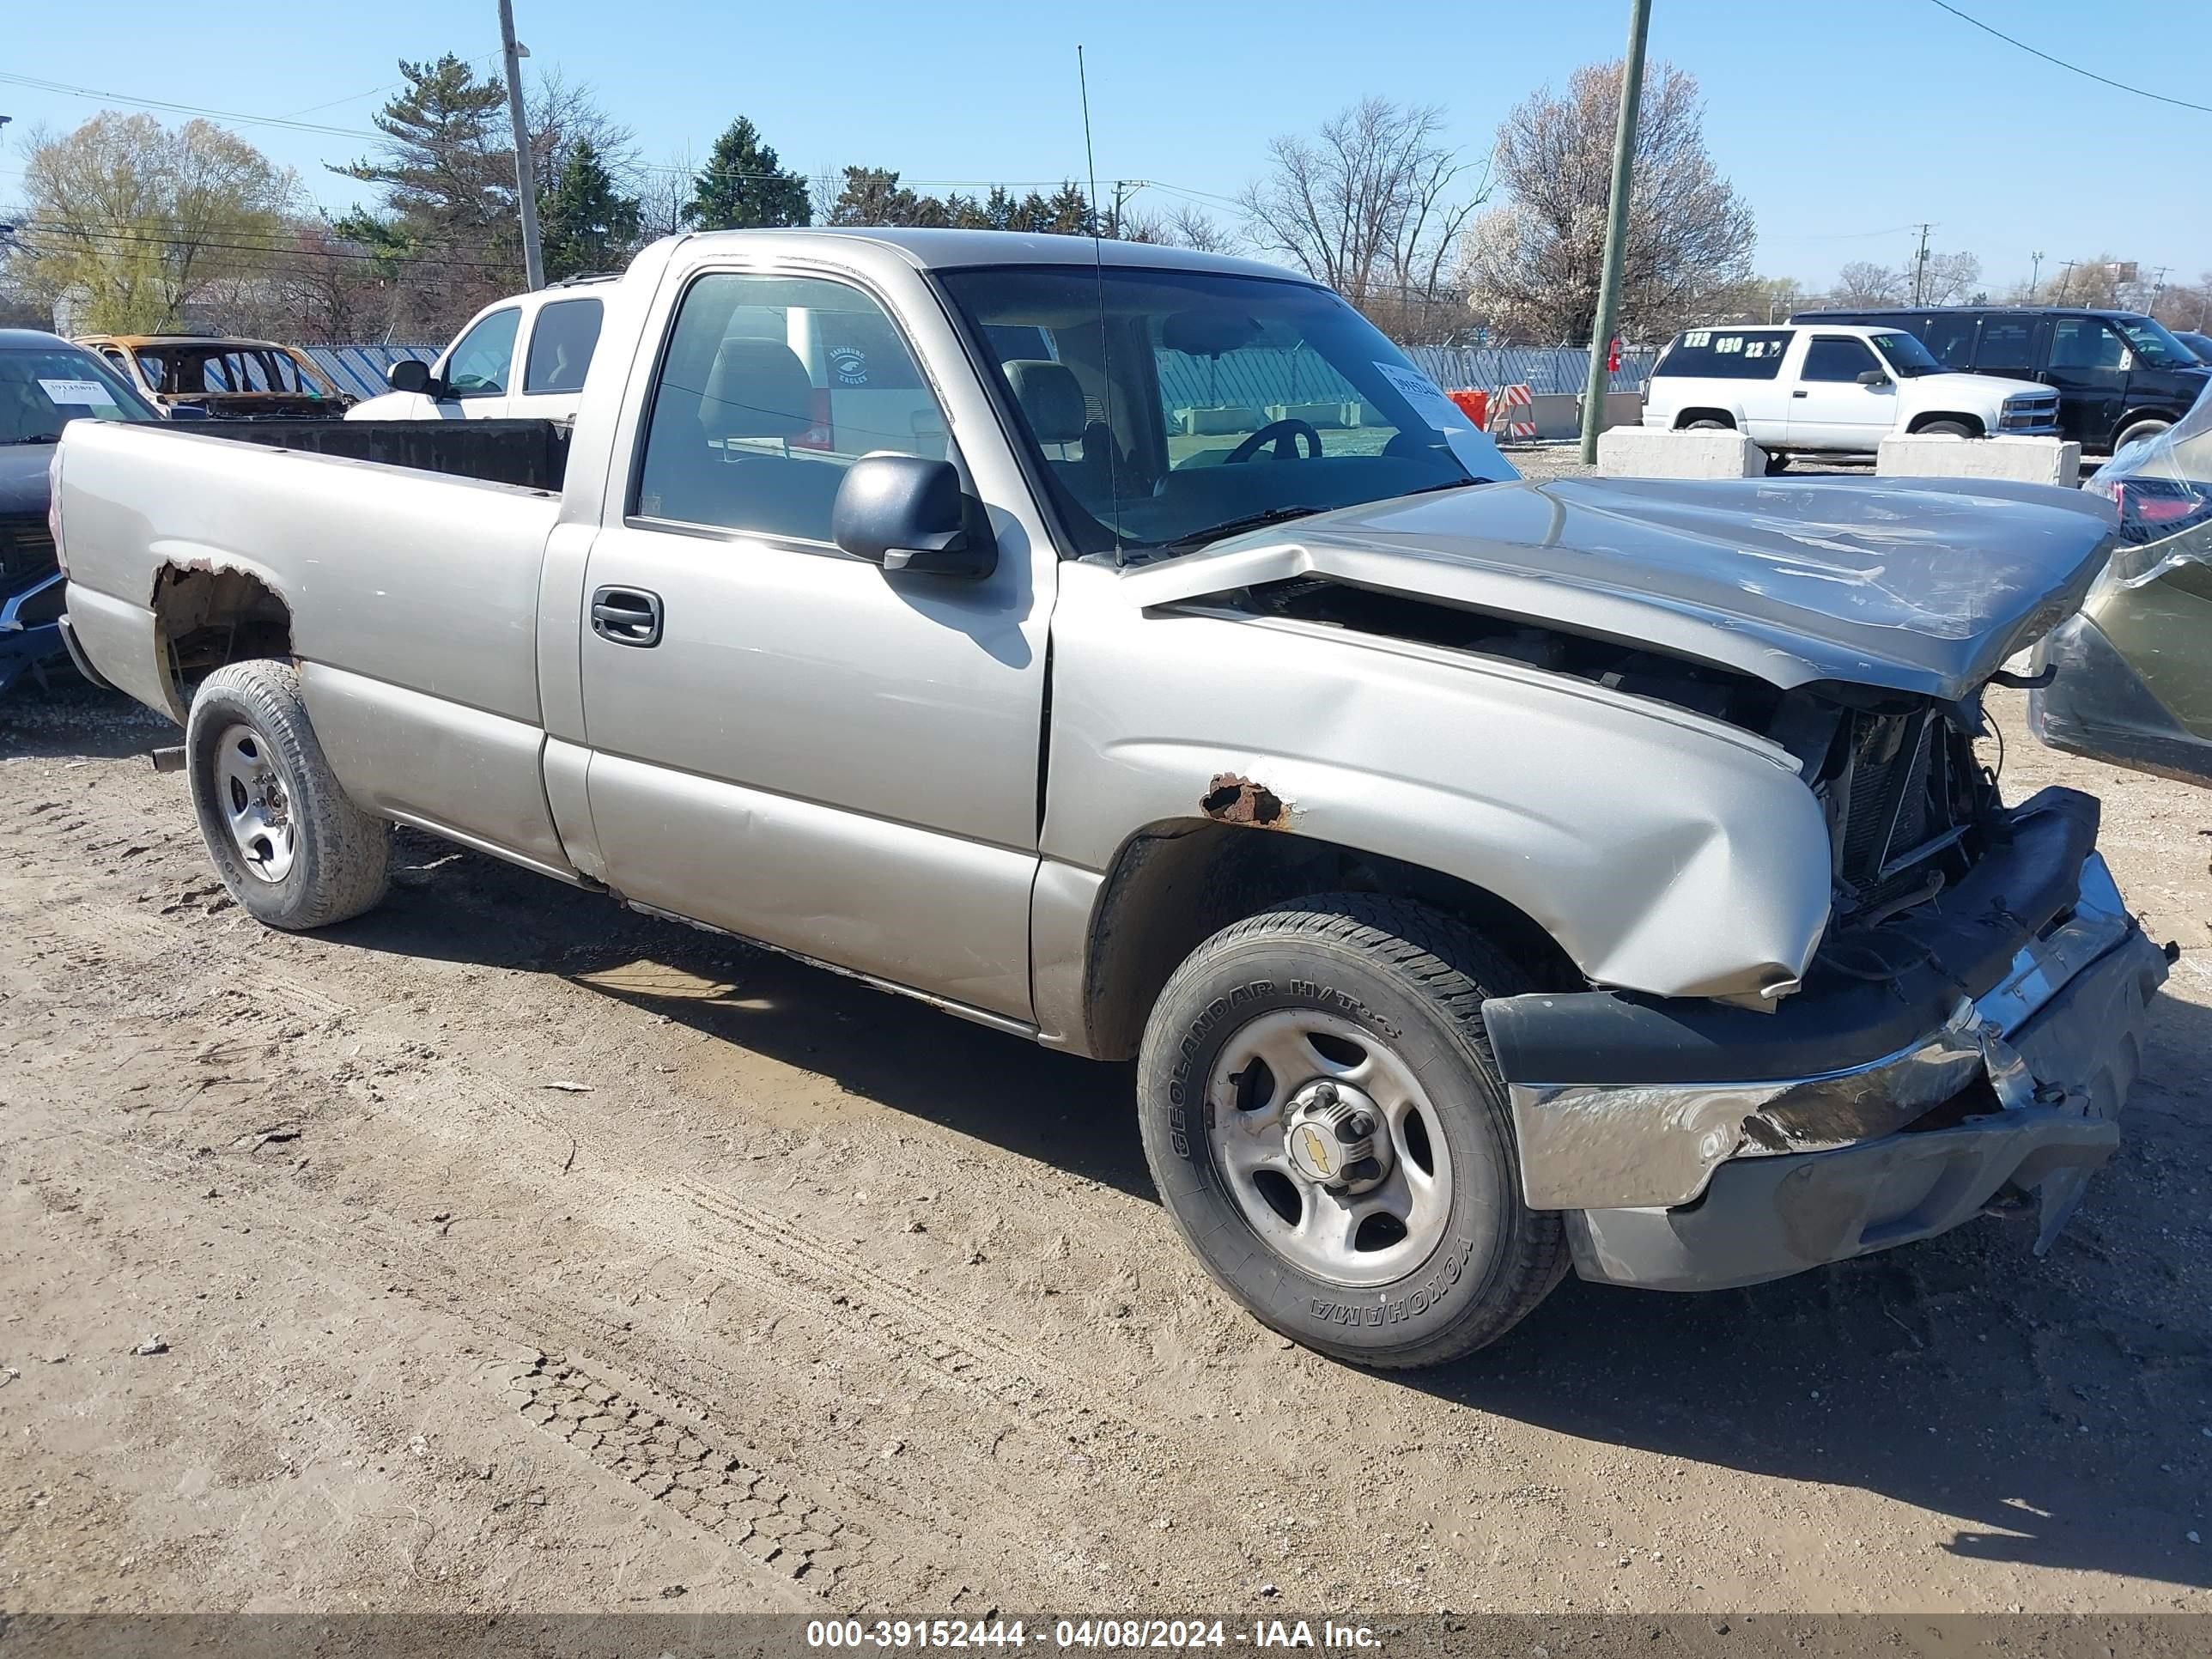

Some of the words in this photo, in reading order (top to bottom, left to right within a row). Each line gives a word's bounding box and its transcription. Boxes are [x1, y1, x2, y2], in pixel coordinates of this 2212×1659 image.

[839, 374, 868, 385] EAGLES
[1168, 979, 1277, 1162] GEOLANDAR
[1310, 1235, 1474, 1327] YOKOHAMA
